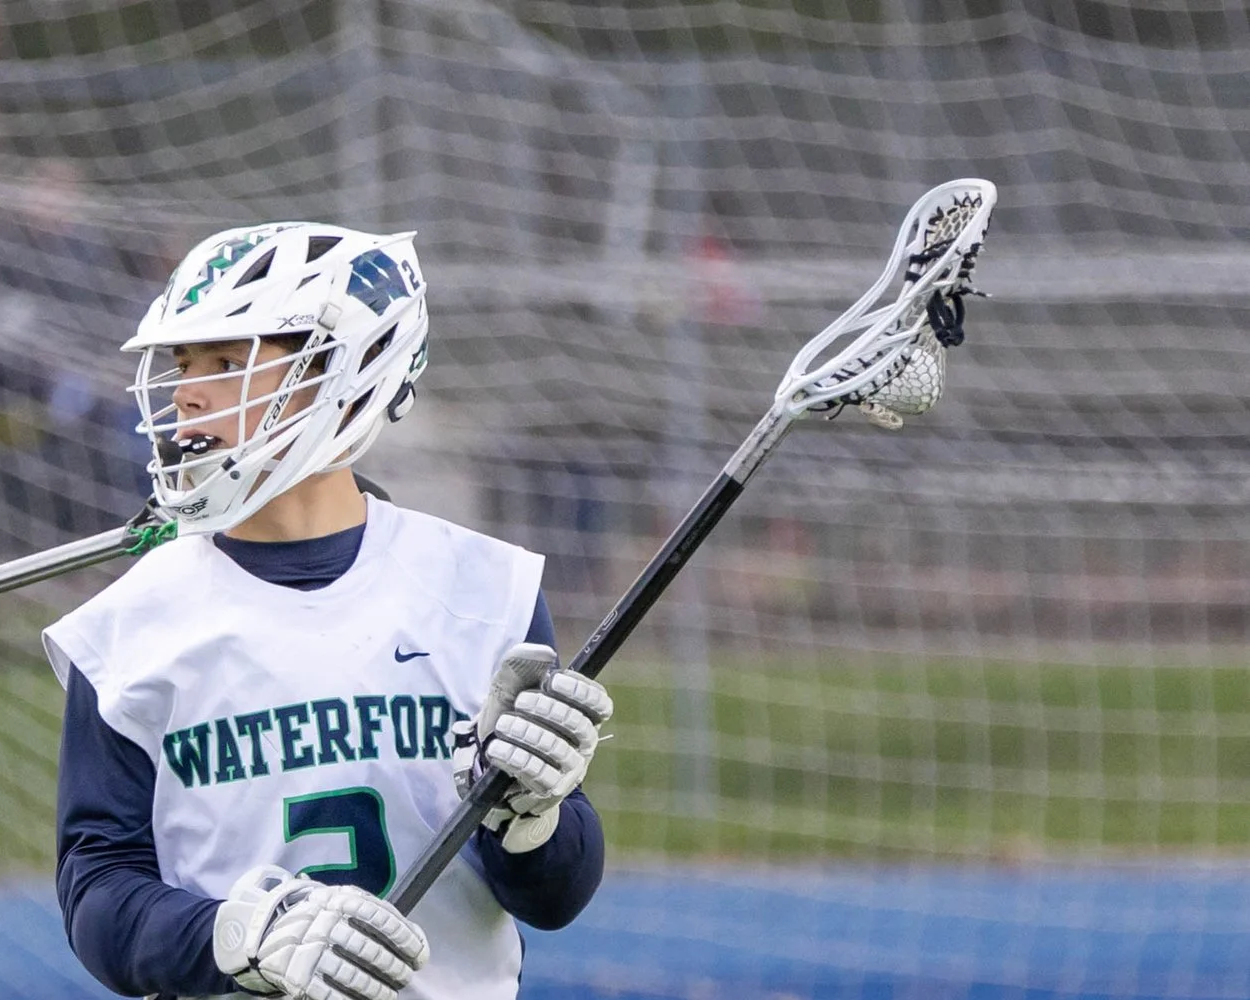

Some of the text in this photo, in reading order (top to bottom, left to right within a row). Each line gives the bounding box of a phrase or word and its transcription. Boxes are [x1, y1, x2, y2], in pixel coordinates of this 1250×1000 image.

[401, 259, 421, 291] 2
[162, 694, 470, 786] WATERFOR
[283, 785, 397, 900] 2
